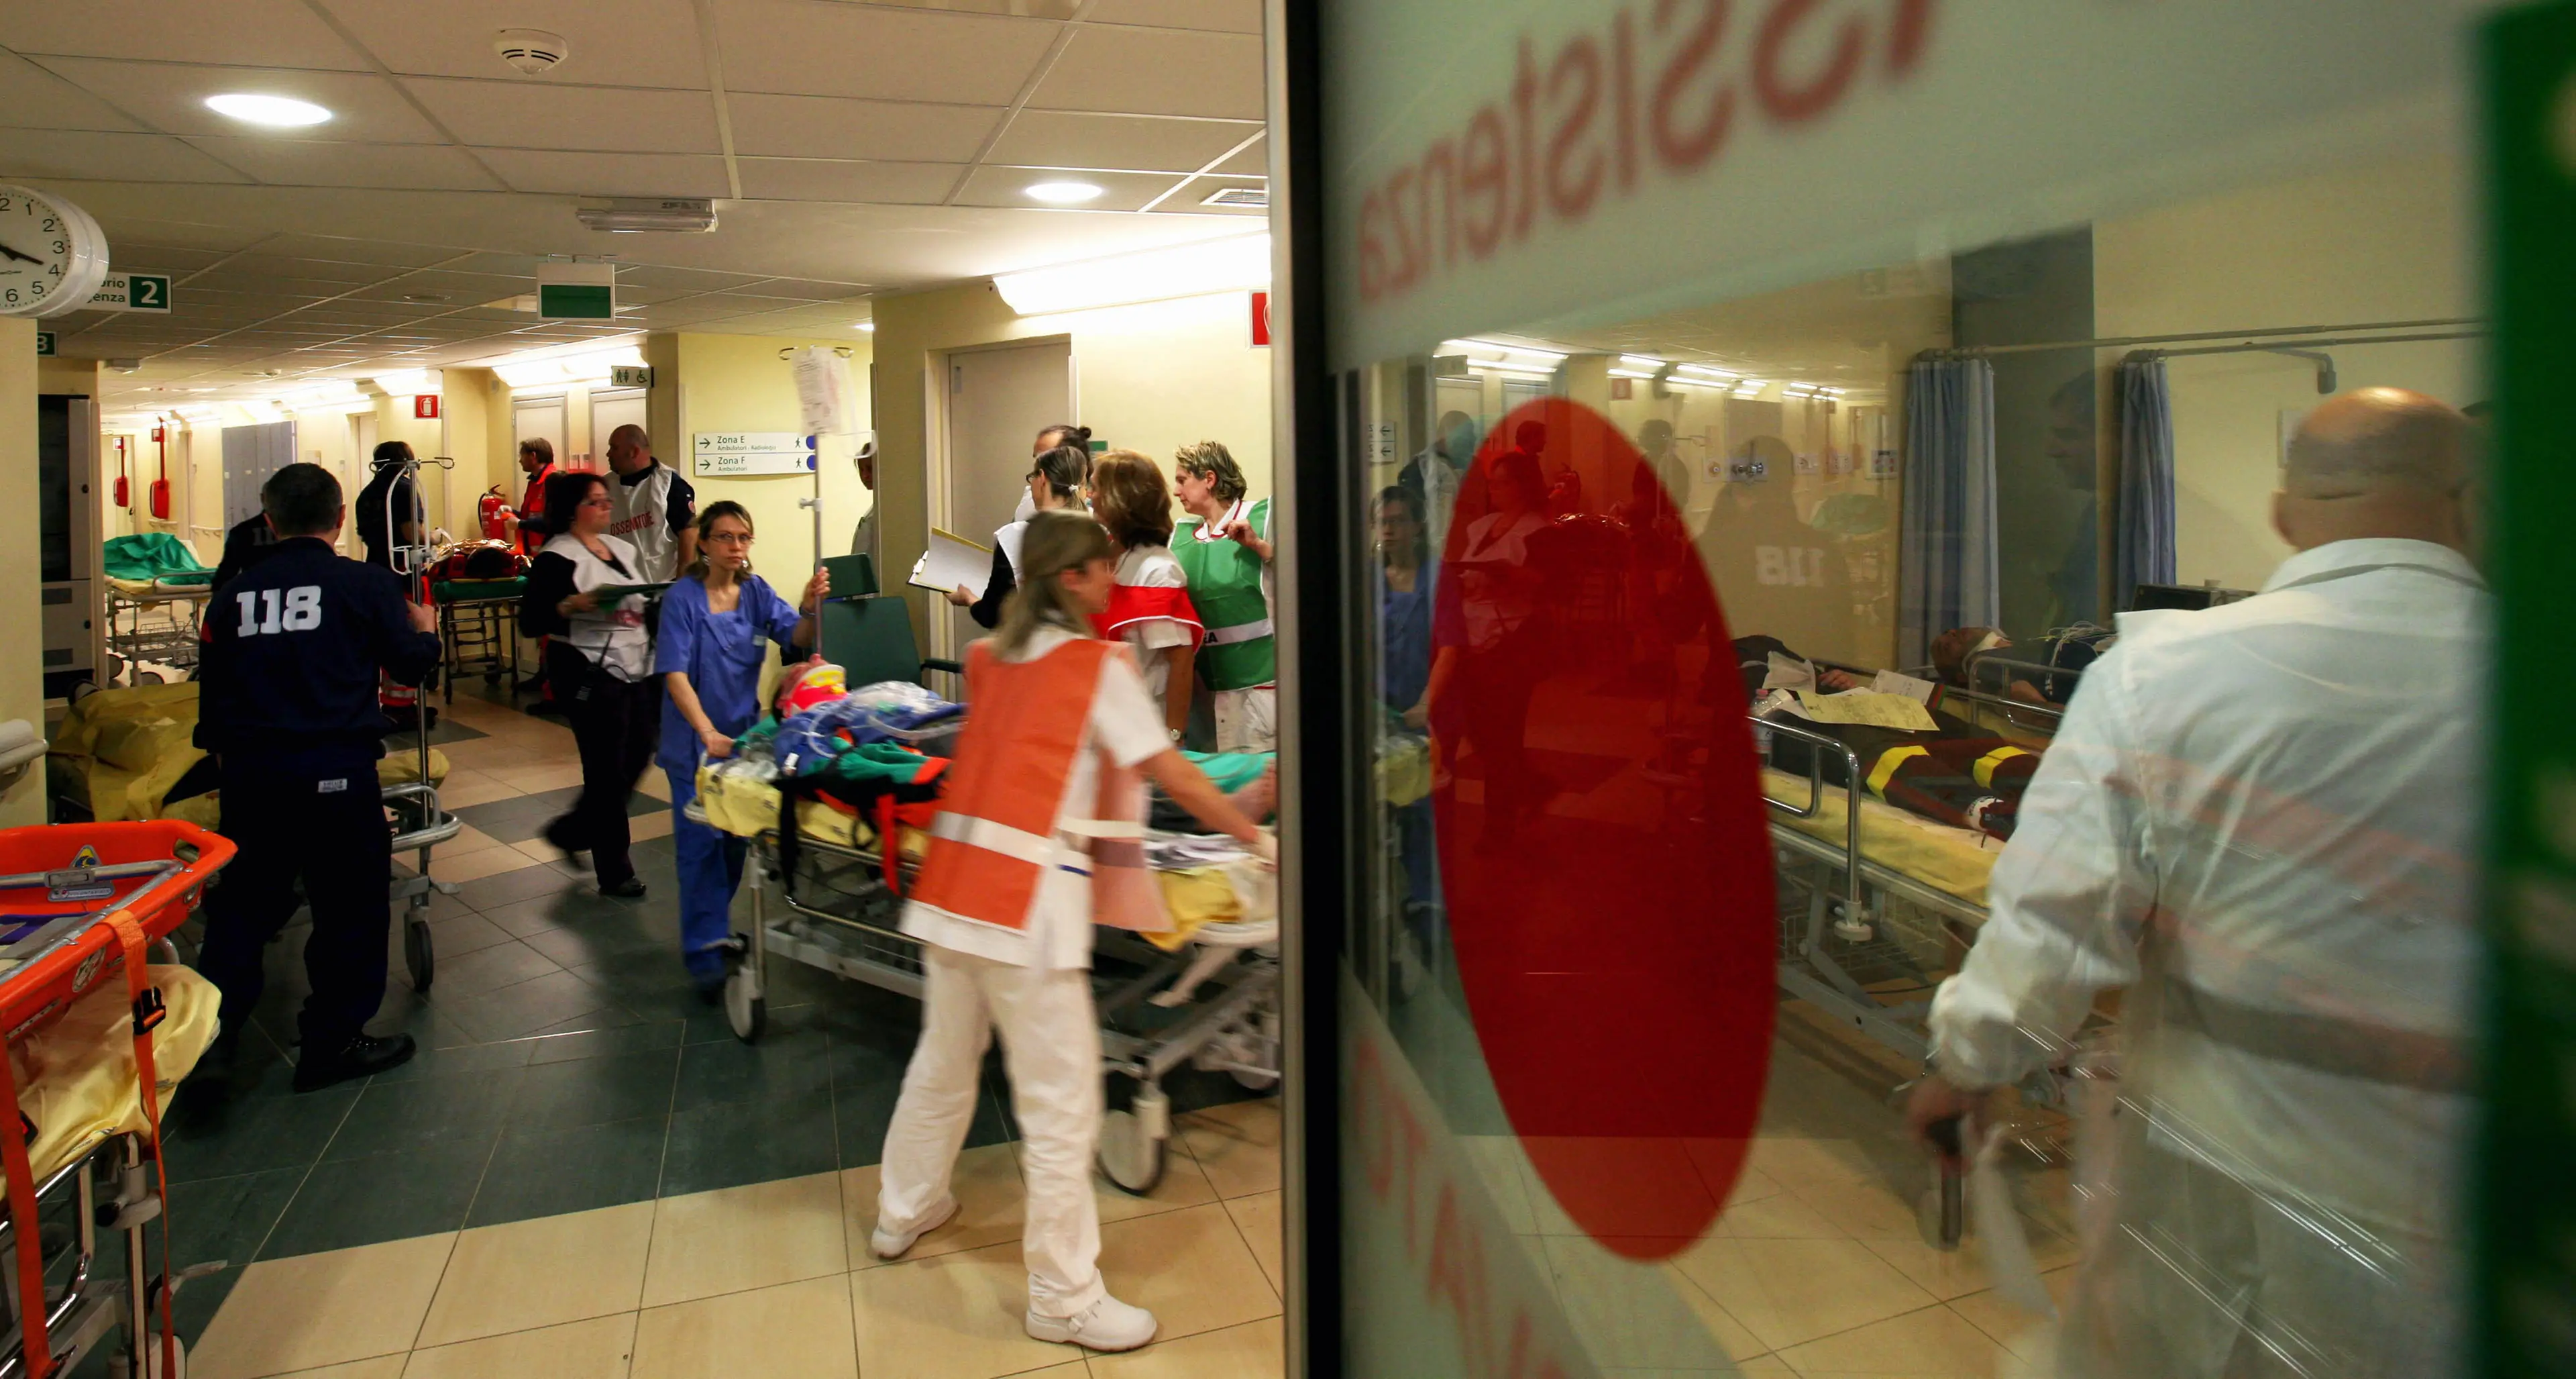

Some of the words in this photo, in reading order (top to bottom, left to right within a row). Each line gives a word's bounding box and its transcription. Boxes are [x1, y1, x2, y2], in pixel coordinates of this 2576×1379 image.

[25, 202, 32, 215] 1
[43, 219, 55, 232] 2
[52, 240, 64, 254] 3
[48, 264, 61, 276] 4
[32, 280, 44, 295] 5
[141, 280, 159, 304] 2
[6, 289, 18, 302] 6
[88, 293, 125, 303] enza
[717, 436, 738, 444] Zona
[740, 436, 745, 444] E
[741, 456, 745, 464] F
[236, 585, 321, 637] 118
